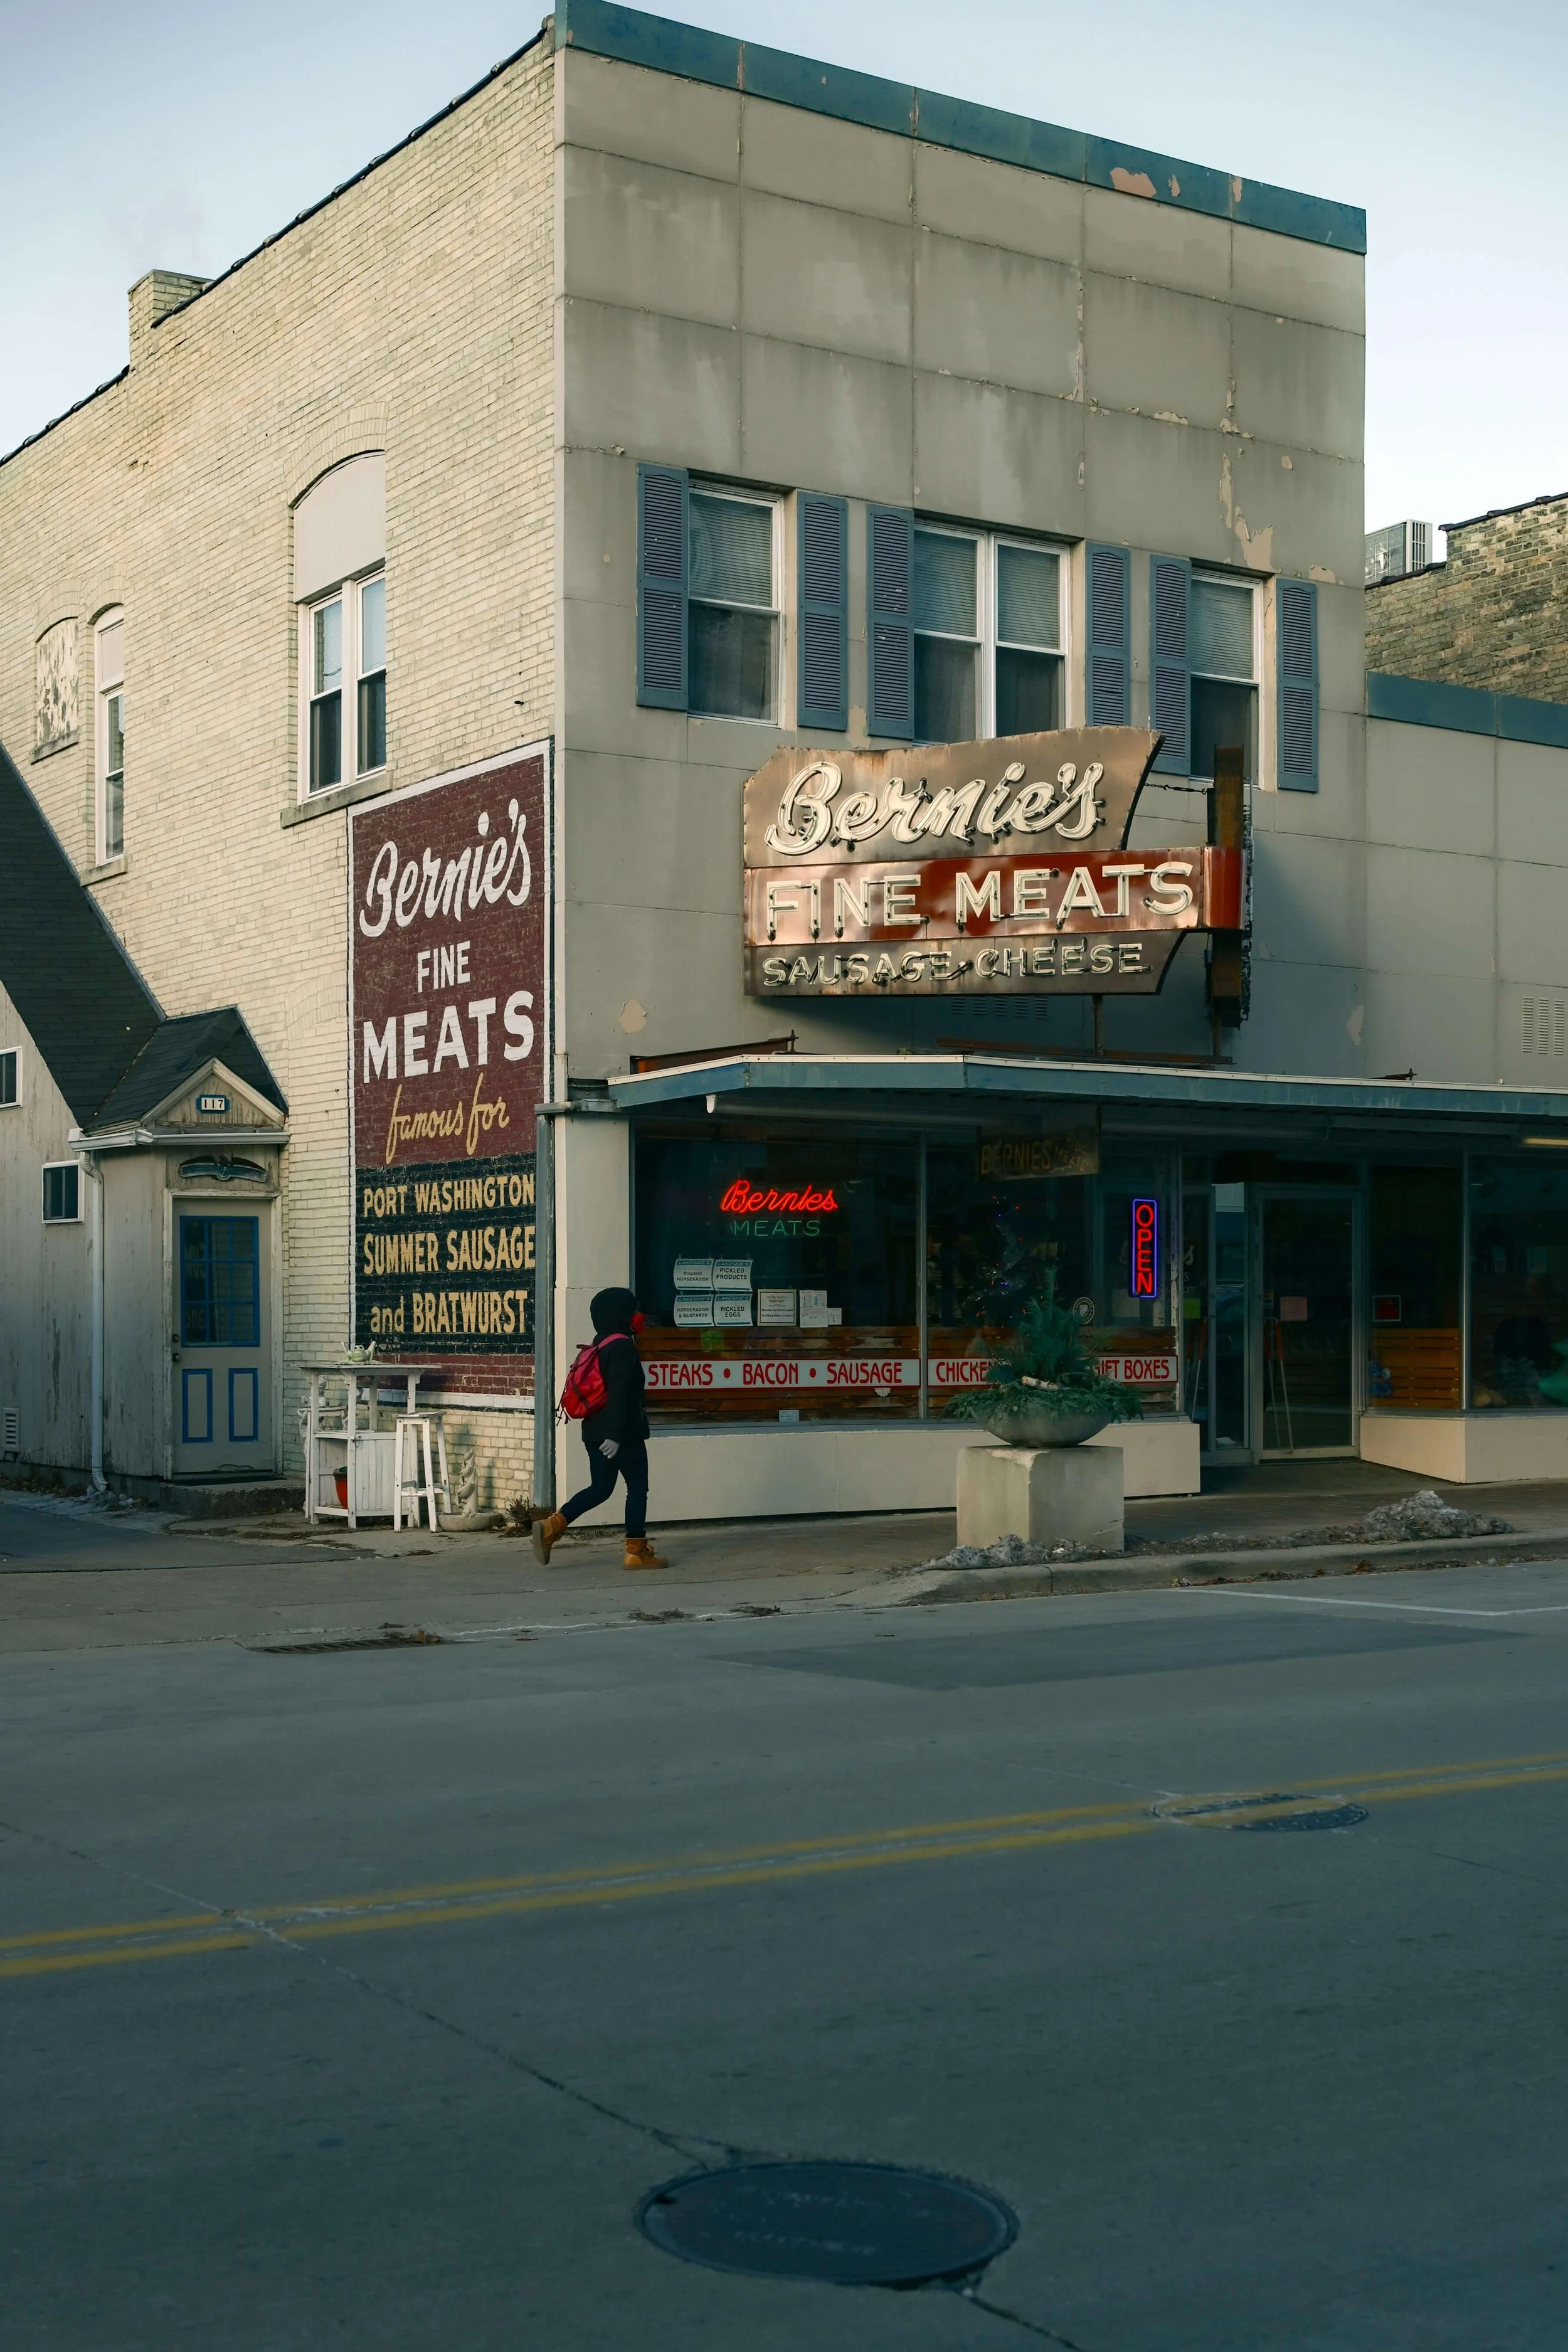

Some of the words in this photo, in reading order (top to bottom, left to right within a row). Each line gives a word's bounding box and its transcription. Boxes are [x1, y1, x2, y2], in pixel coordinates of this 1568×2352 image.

[765, 761, 1104, 856] Bernie's
[359, 798, 531, 937] Bernie's
[766, 873, 922, 938] FINE
[955, 861, 1194, 927] MEATS
[417, 941, 471, 993] FINE
[761, 950, 953, 987] SAUSAGE
[975, 942, 1145, 979] CHEESE
[363, 990, 534, 1084] MEATS
[203, 1099, 223, 1108] 117
[386, 1084, 463, 1165] famous
[466, 1072, 509, 1155] for
[364, 1185, 408, 1217] PORT
[415, 1173, 534, 1213] WASHINGTON
[363, 1232, 439, 1275] SUMMER
[447, 1226, 535, 1271] SAUSAGE
[733, 1221, 820, 1236] MEATS
[1135, 1204, 1154, 1293] OPEN
[371, 1296, 404, 1332] and
[412, 1290, 527, 1333] BRATWURST
[649, 1364, 713, 1385] STEAKS
[743, 1363, 798, 1384] BACON
[827, 1362, 902, 1384] SAUSAGE
[936, 1362, 993, 1382] CHICKE
[1125, 1360, 1170, 1379] BOXES
